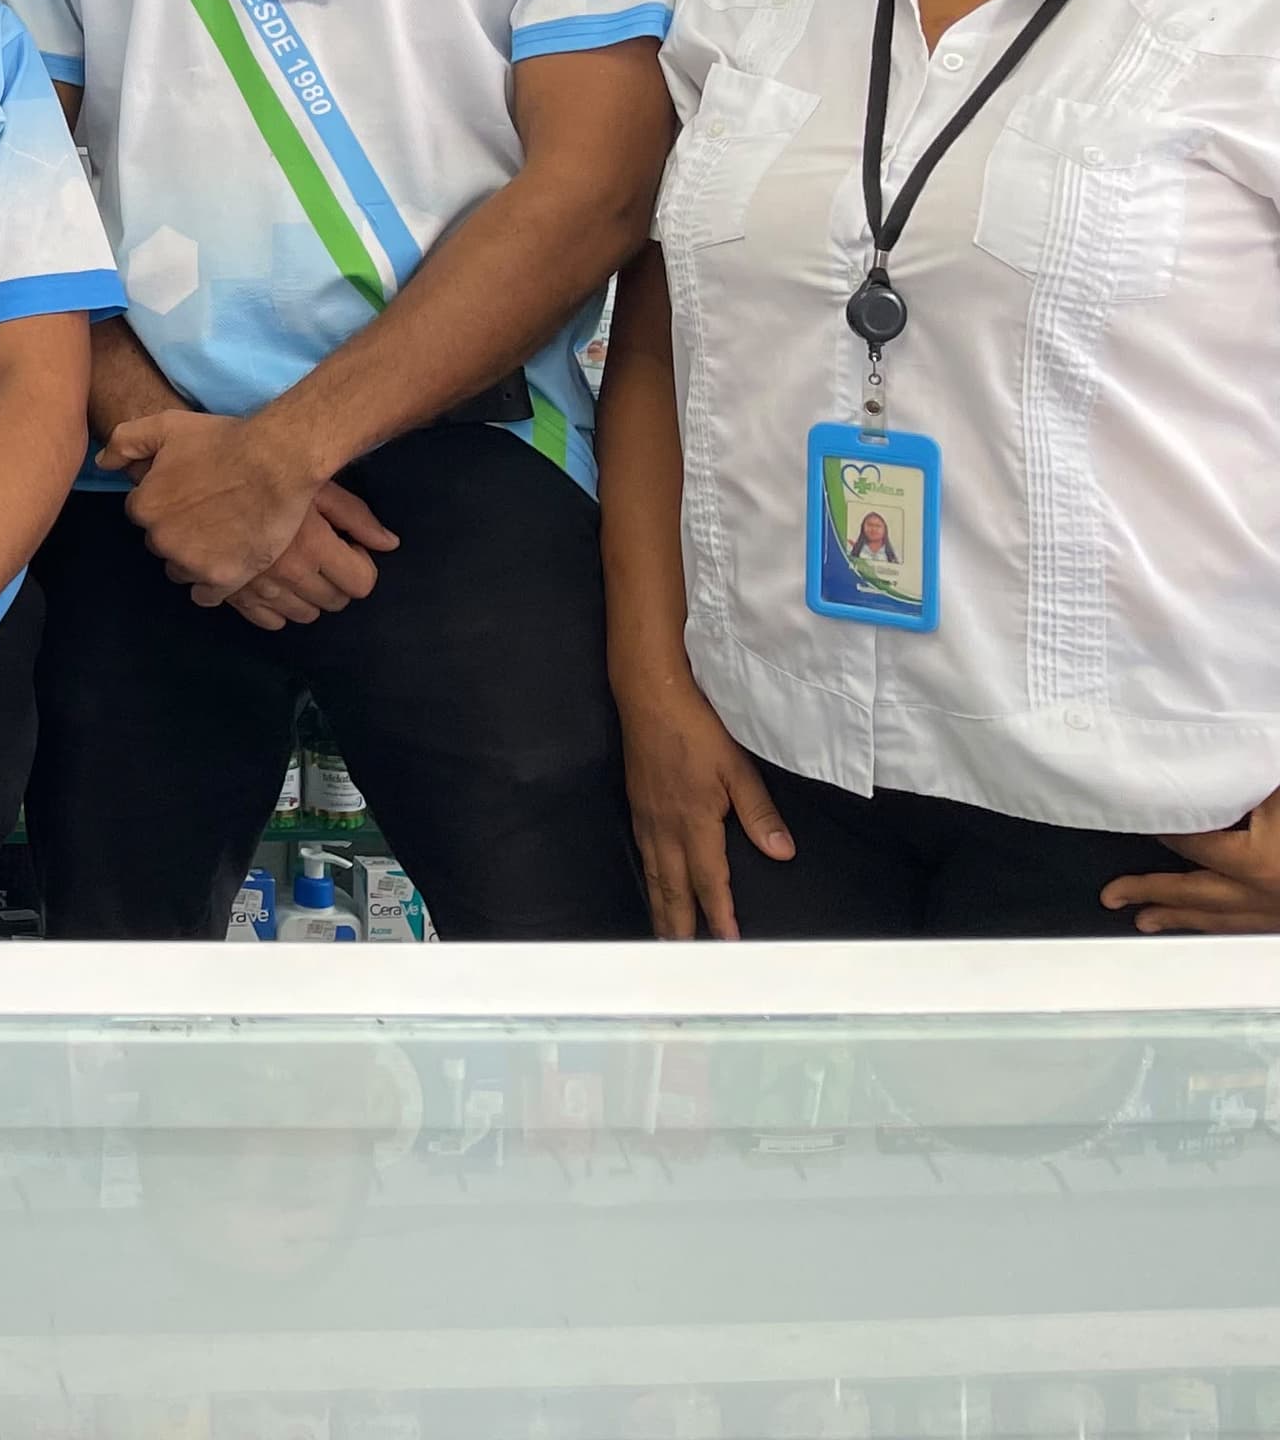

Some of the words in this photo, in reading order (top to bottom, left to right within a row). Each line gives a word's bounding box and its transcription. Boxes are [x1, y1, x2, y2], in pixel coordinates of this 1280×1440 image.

[283, 58, 332, 116] 1980
[231, 910, 269, 923] raVe
[369, 903, 418, 918] CeraVe
